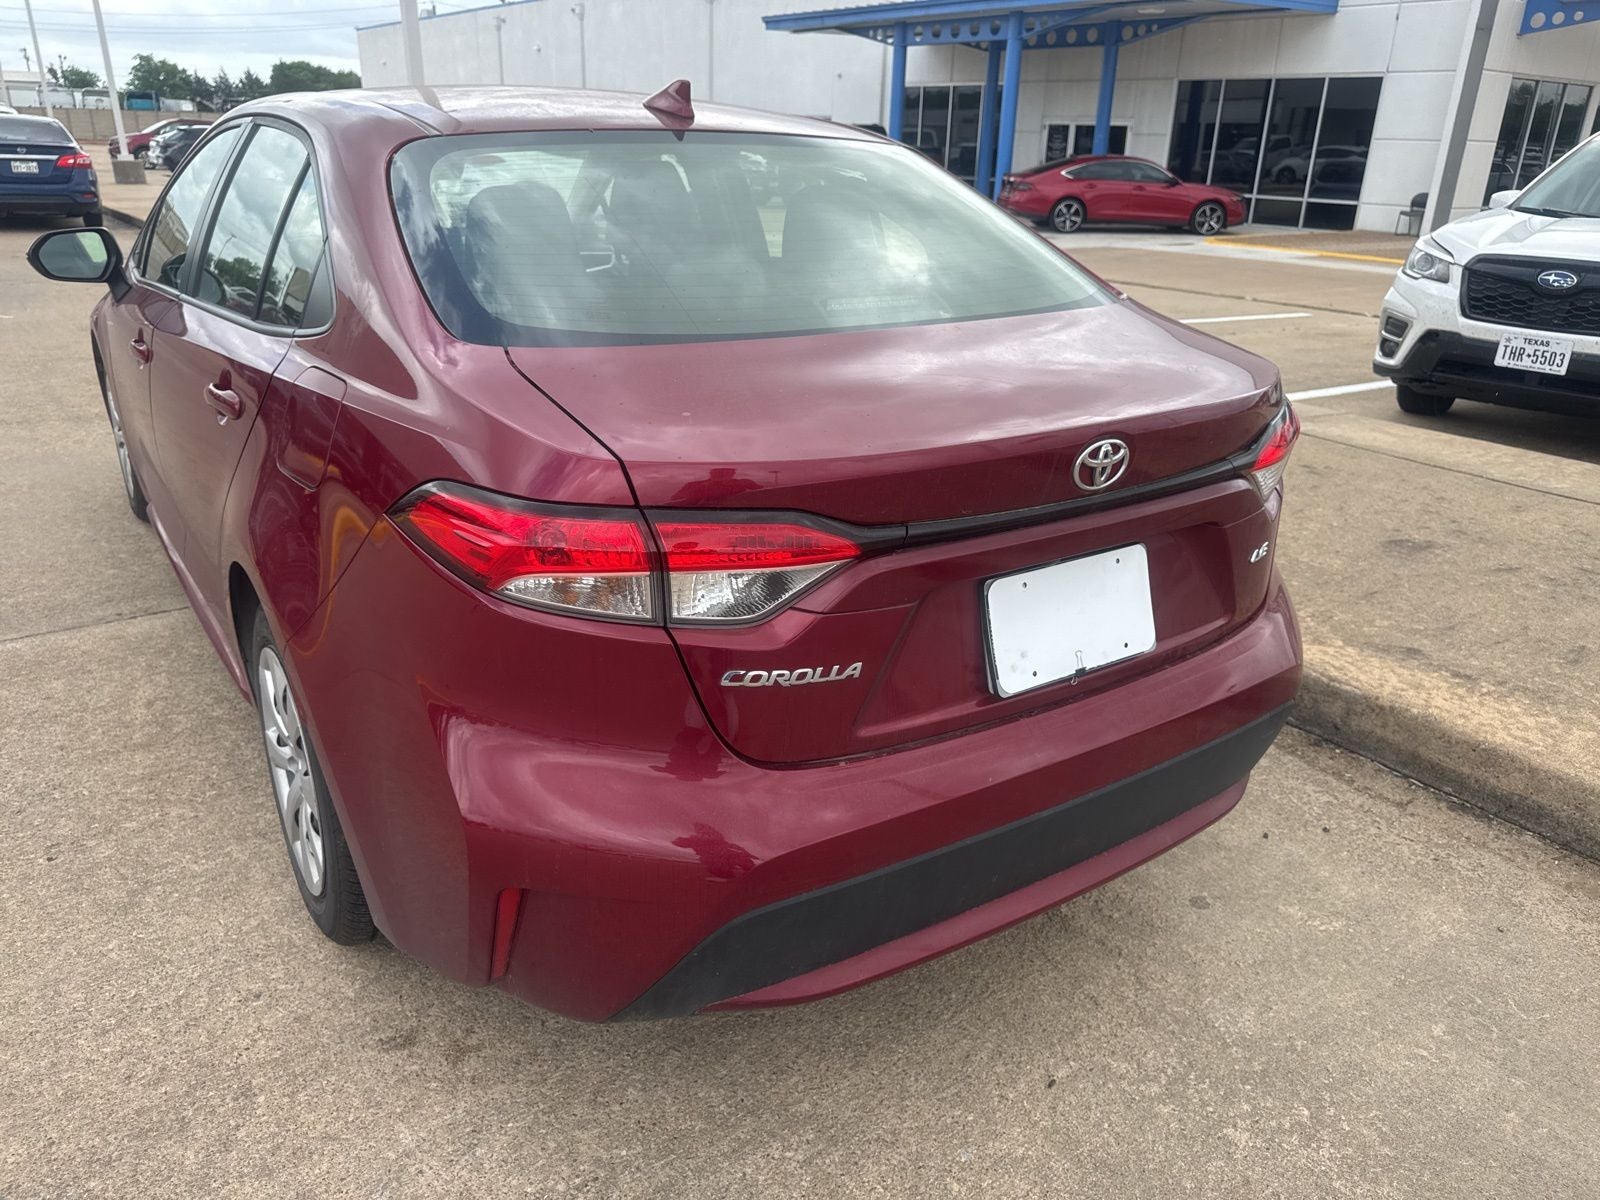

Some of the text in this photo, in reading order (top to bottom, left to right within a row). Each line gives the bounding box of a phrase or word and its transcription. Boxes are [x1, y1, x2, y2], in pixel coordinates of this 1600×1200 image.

[1523, 337, 1551, 347] TEXAS
[1250, 541, 1269, 563] LE
[720, 662, 863, 687] COROLLA
